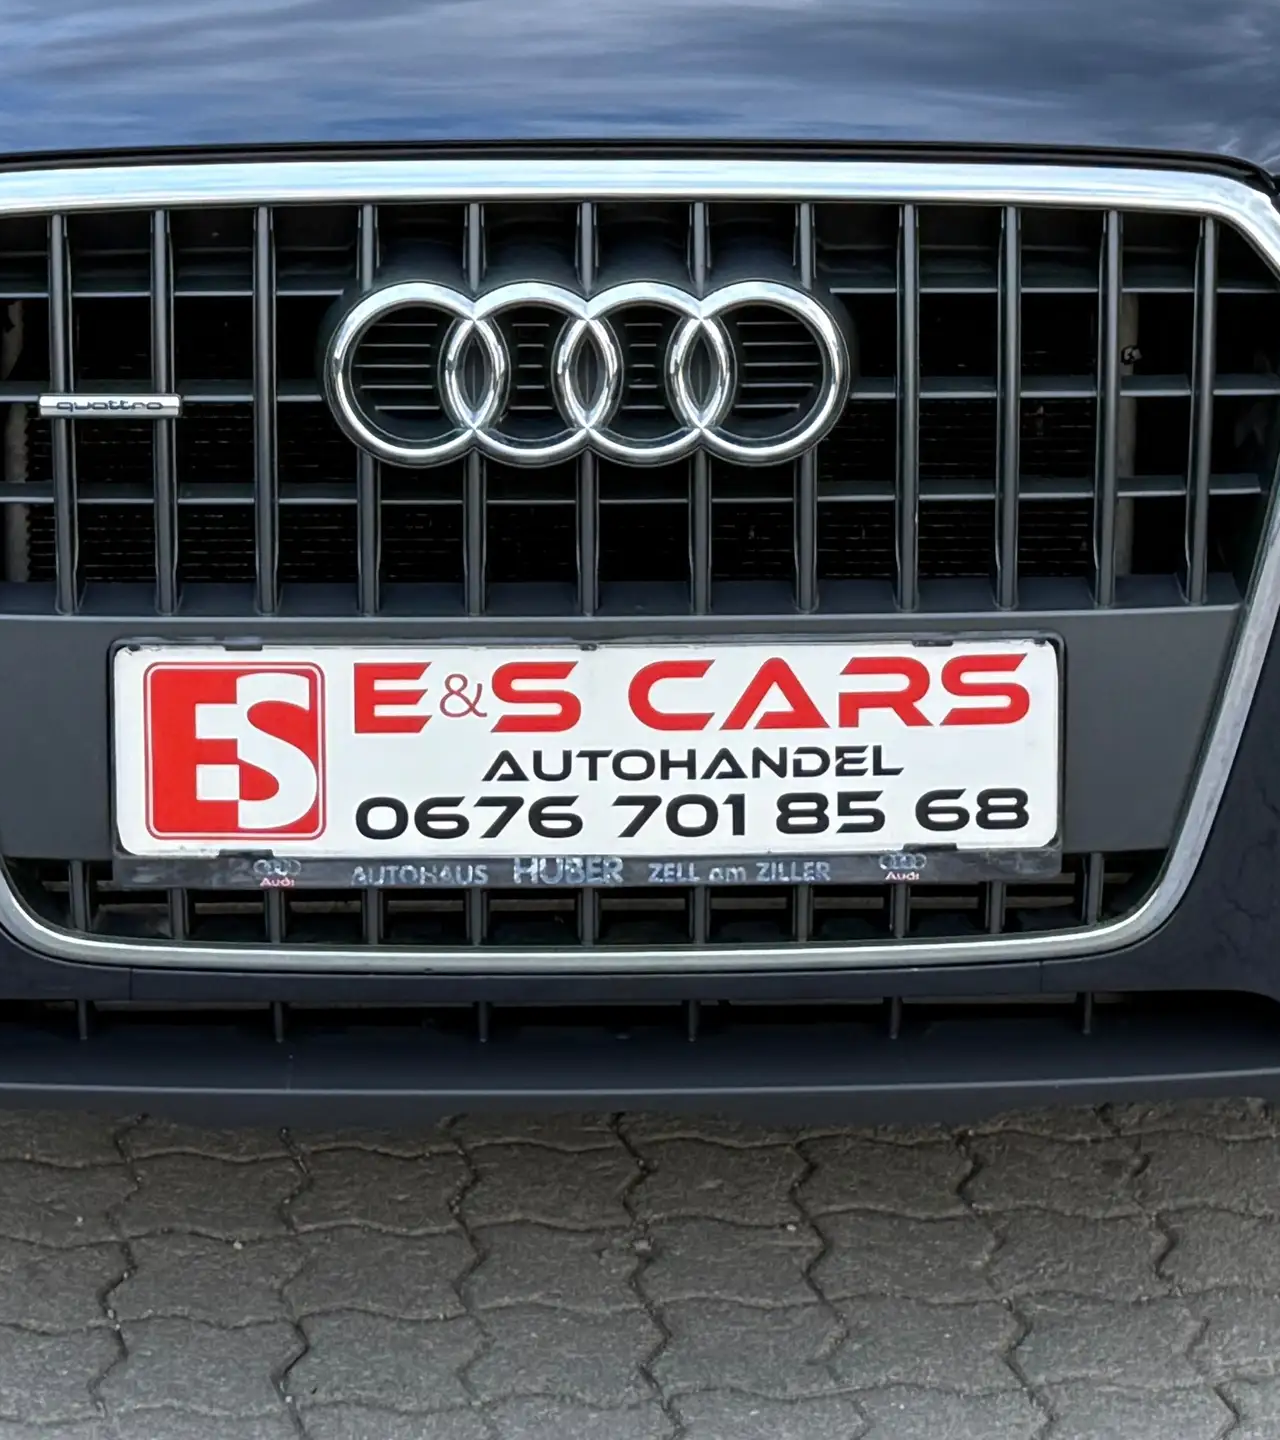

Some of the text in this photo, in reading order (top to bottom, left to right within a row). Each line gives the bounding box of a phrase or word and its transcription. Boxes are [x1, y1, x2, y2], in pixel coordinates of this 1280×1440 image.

[56, 400, 164, 412] quattro
[354, 653, 1030, 734] E&S CARS
[151, 670, 319, 832] ES
[481, 744, 905, 782] AUTOHANDEL
[355, 787, 1030, 840] 0676 701 85 68
[260, 877, 295, 888] Audi
[351, 864, 488, 886] AUTOHAUS
[648, 863, 700, 882] ZELL
[755, 861, 831, 882] ZILLER
[885, 871, 920, 881] Audi
